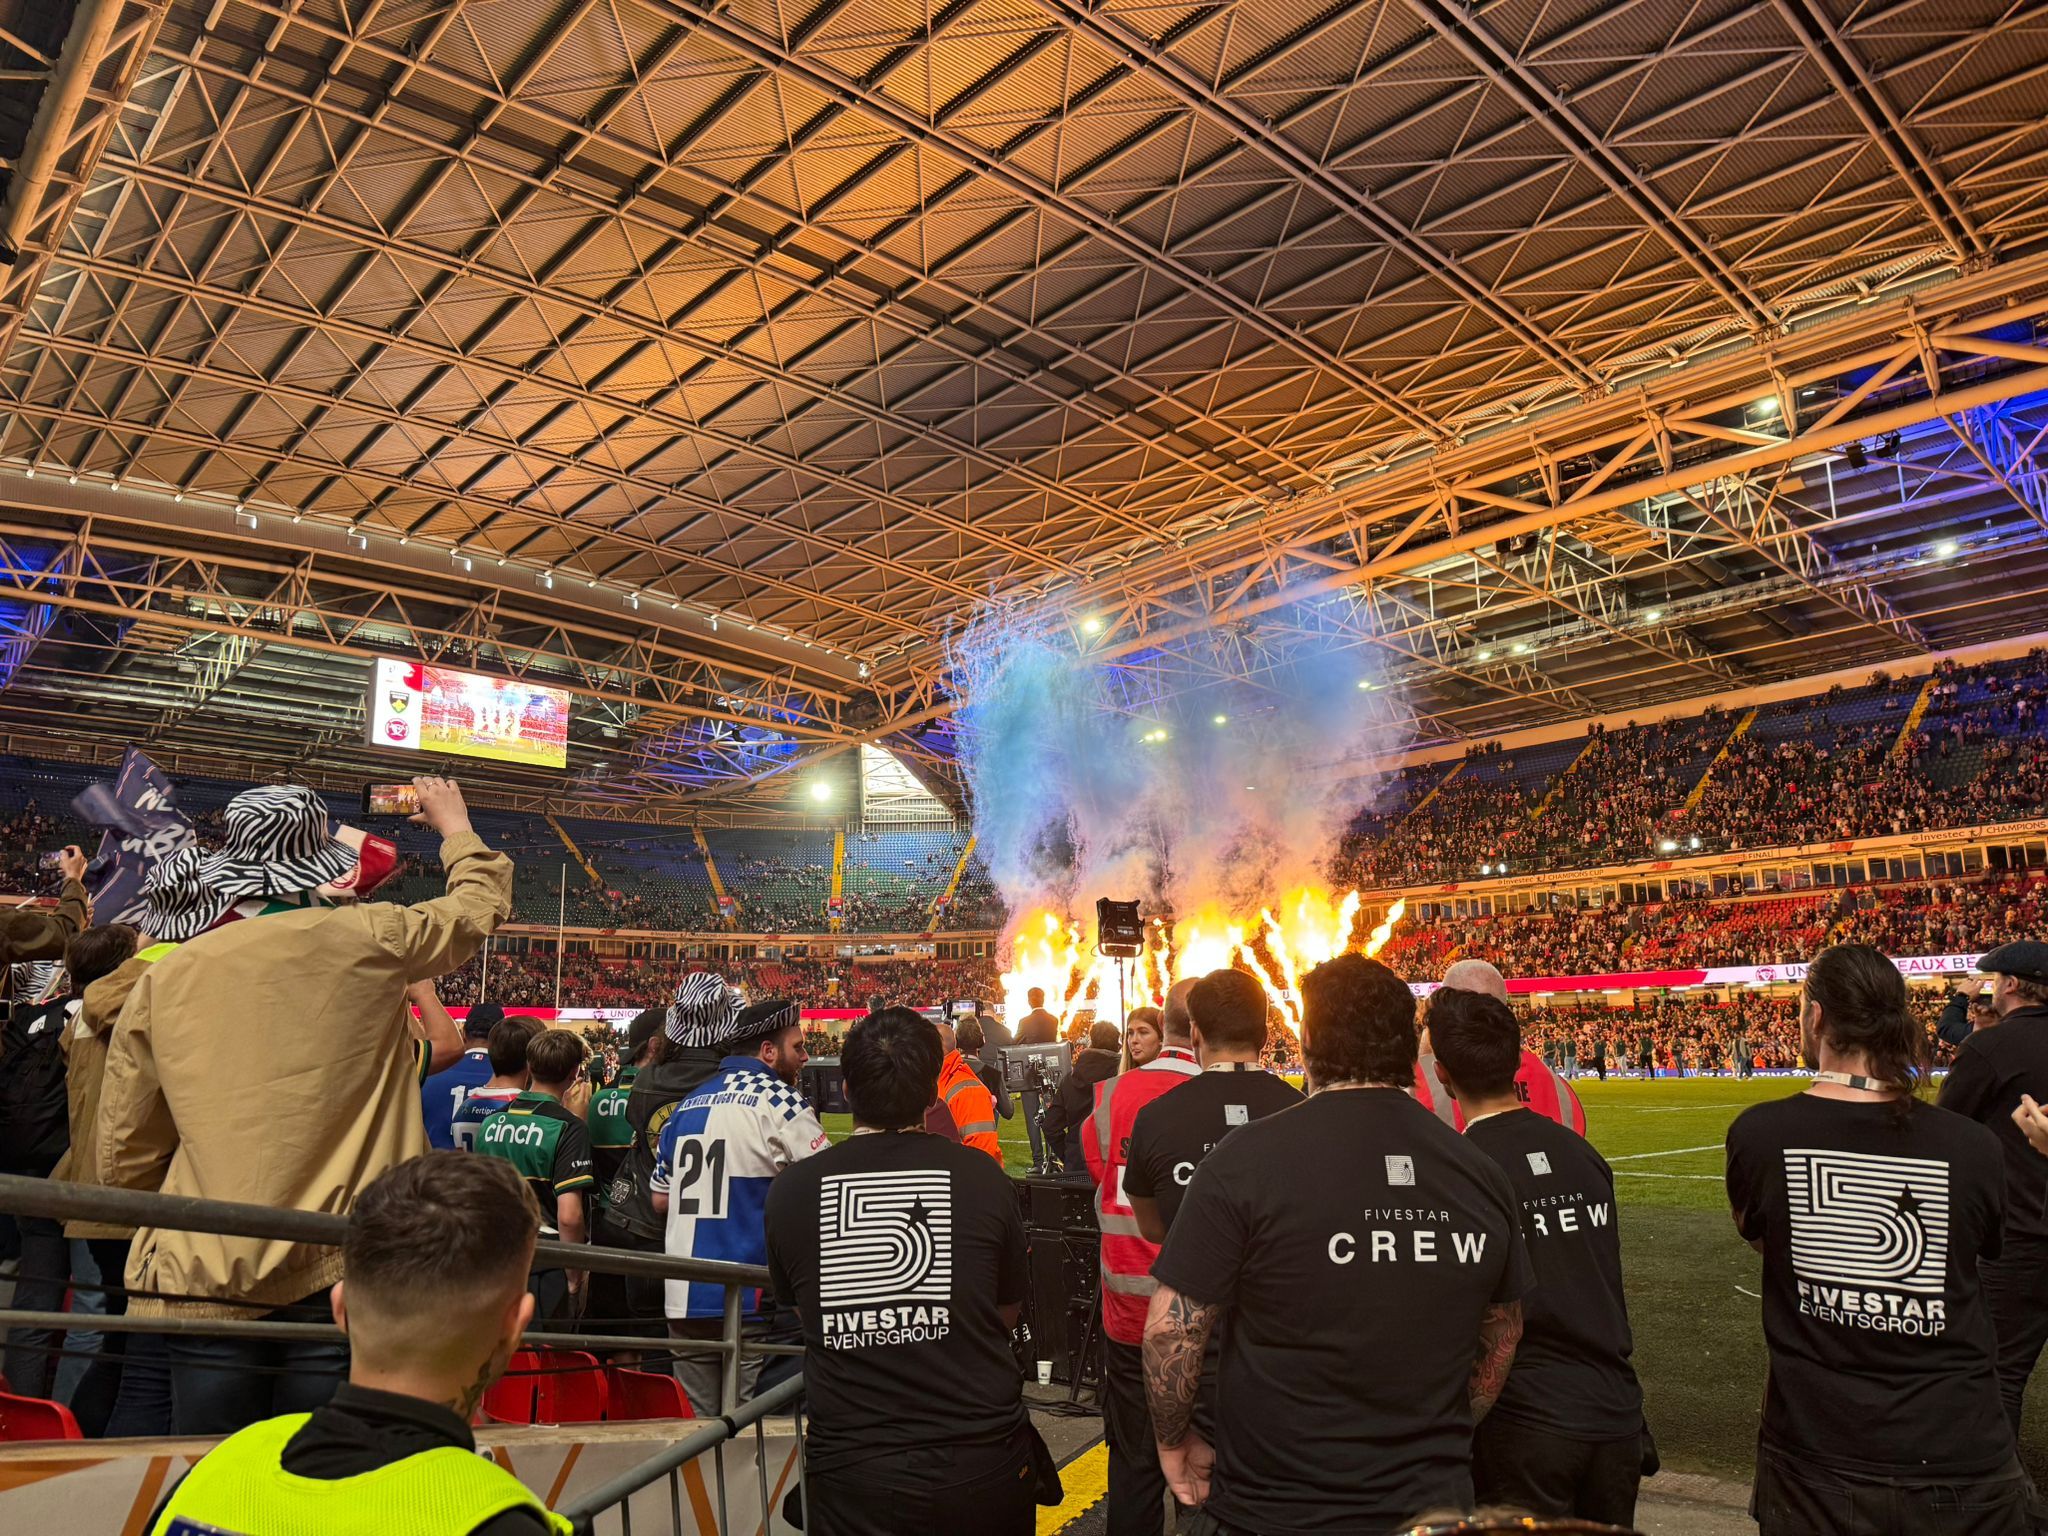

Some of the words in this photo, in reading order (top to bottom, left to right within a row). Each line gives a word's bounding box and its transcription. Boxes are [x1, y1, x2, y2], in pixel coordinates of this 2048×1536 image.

[1920, 830, 1965, 842] Investec
[1986, 820, 2047, 834] CHAMPIONS
[1748, 851, 1772, 859] FINAL
[1503, 877, 1532, 885] Investec
[1547, 870, 1589, 880] CHAMPIONS
[1589, 868, 1604, 876] CUP
[1897, 958, 1947, 972] EAUX
[711, 1092, 738, 1105] RUGBY
[737, 1093, 759, 1108] CLUB
[484, 1115, 544, 1146] cinch
[678, 1138, 726, 1215] 21
[1523, 1192, 1584, 1210] FVESTAR
[1364, 1208, 1450, 1223] FIVESTAR
[1520, 1202, 1609, 1240] REW
[1327, 1230, 1487, 1265] CREW
[1797, 1279, 1946, 1320] FIVESTAR
[822, 1306, 949, 1334] FIVESTAR
[1799, 1298, 1946, 1337] EVENTSGROUP
[823, 1326, 950, 1350] EVENTSGROUP
